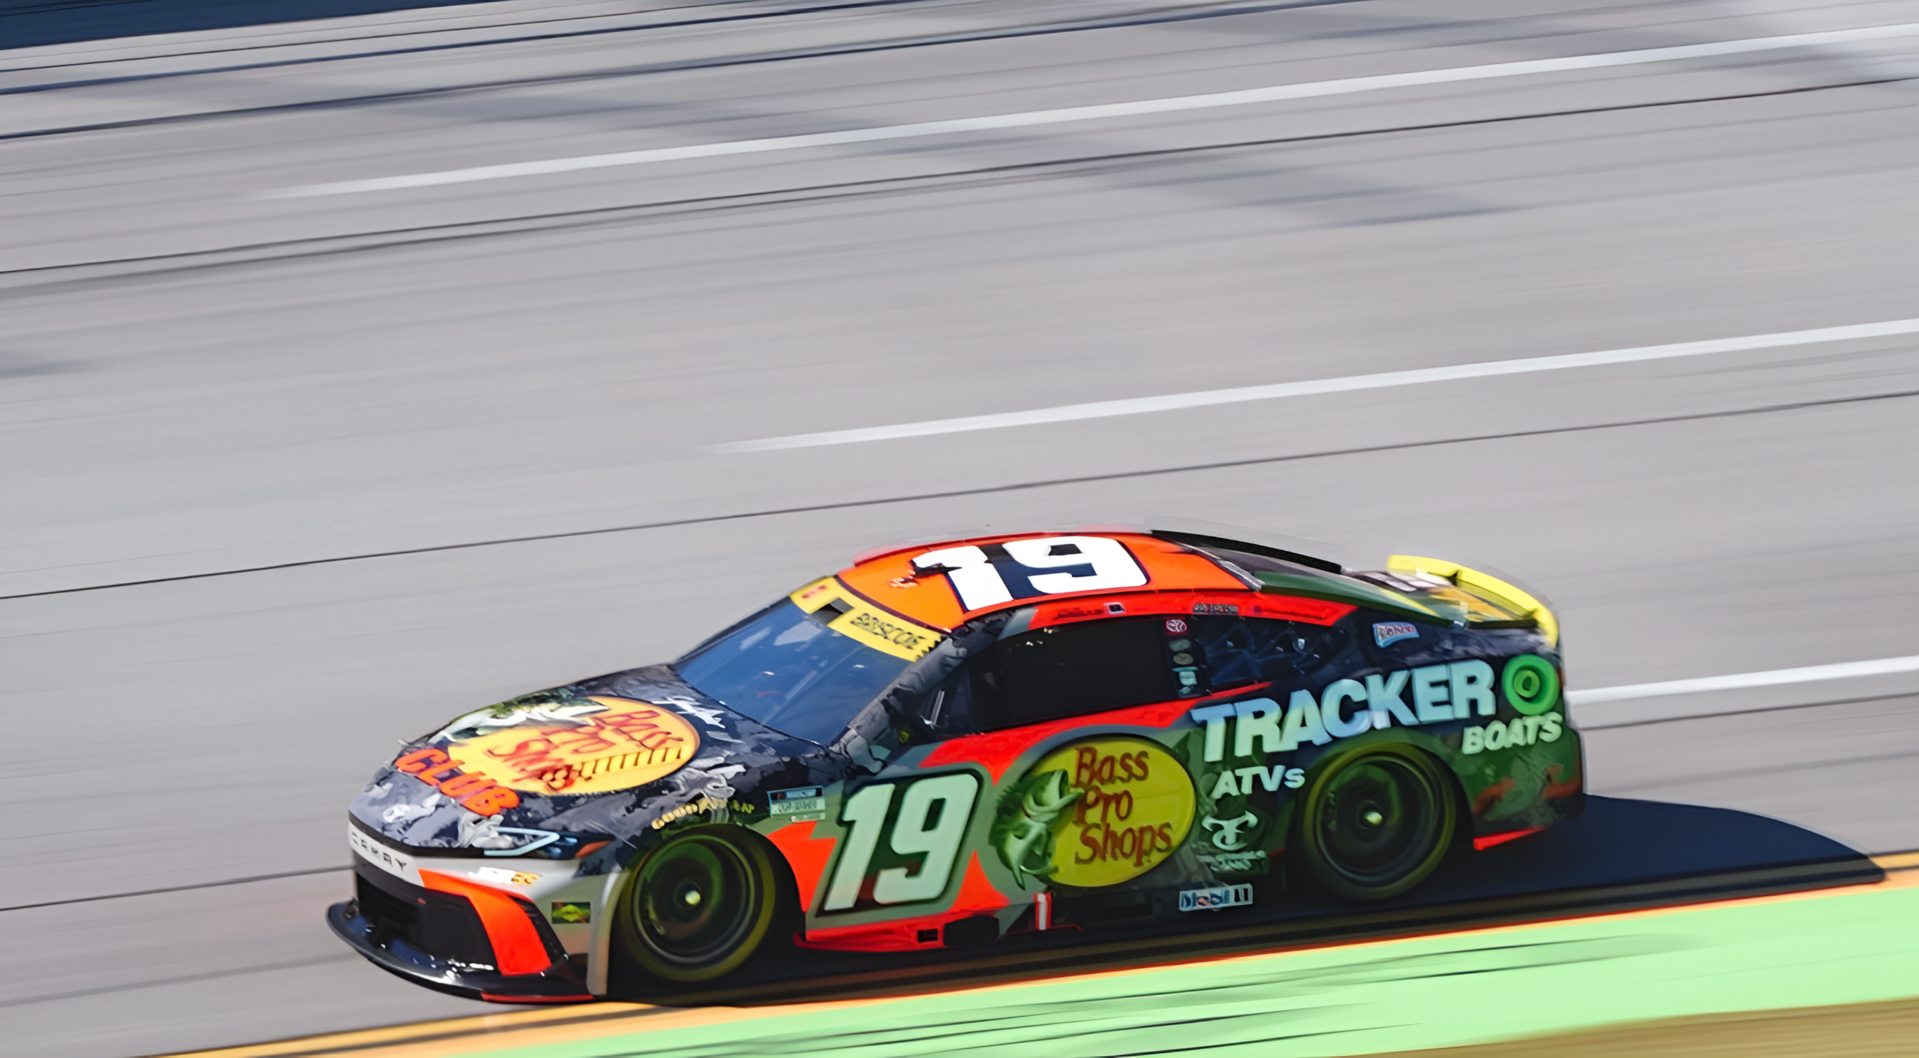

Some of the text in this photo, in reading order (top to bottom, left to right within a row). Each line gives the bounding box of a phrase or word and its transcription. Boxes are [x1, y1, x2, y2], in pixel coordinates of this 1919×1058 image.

[911, 536, 1148, 612] 19
[850, 613, 927, 650] BRISCOE
[1190, 659, 1497, 763] TRACKER
[1462, 711, 1563, 755] BOATS
[394, 747, 520, 818] CLUB
[1071, 746, 1150, 788] Bass
[1211, 764, 1306, 800] ATVs
[1072, 785, 1133, 828] Pro
[823, 773, 980, 912] 19
[1074, 822, 1174, 868] Shops
